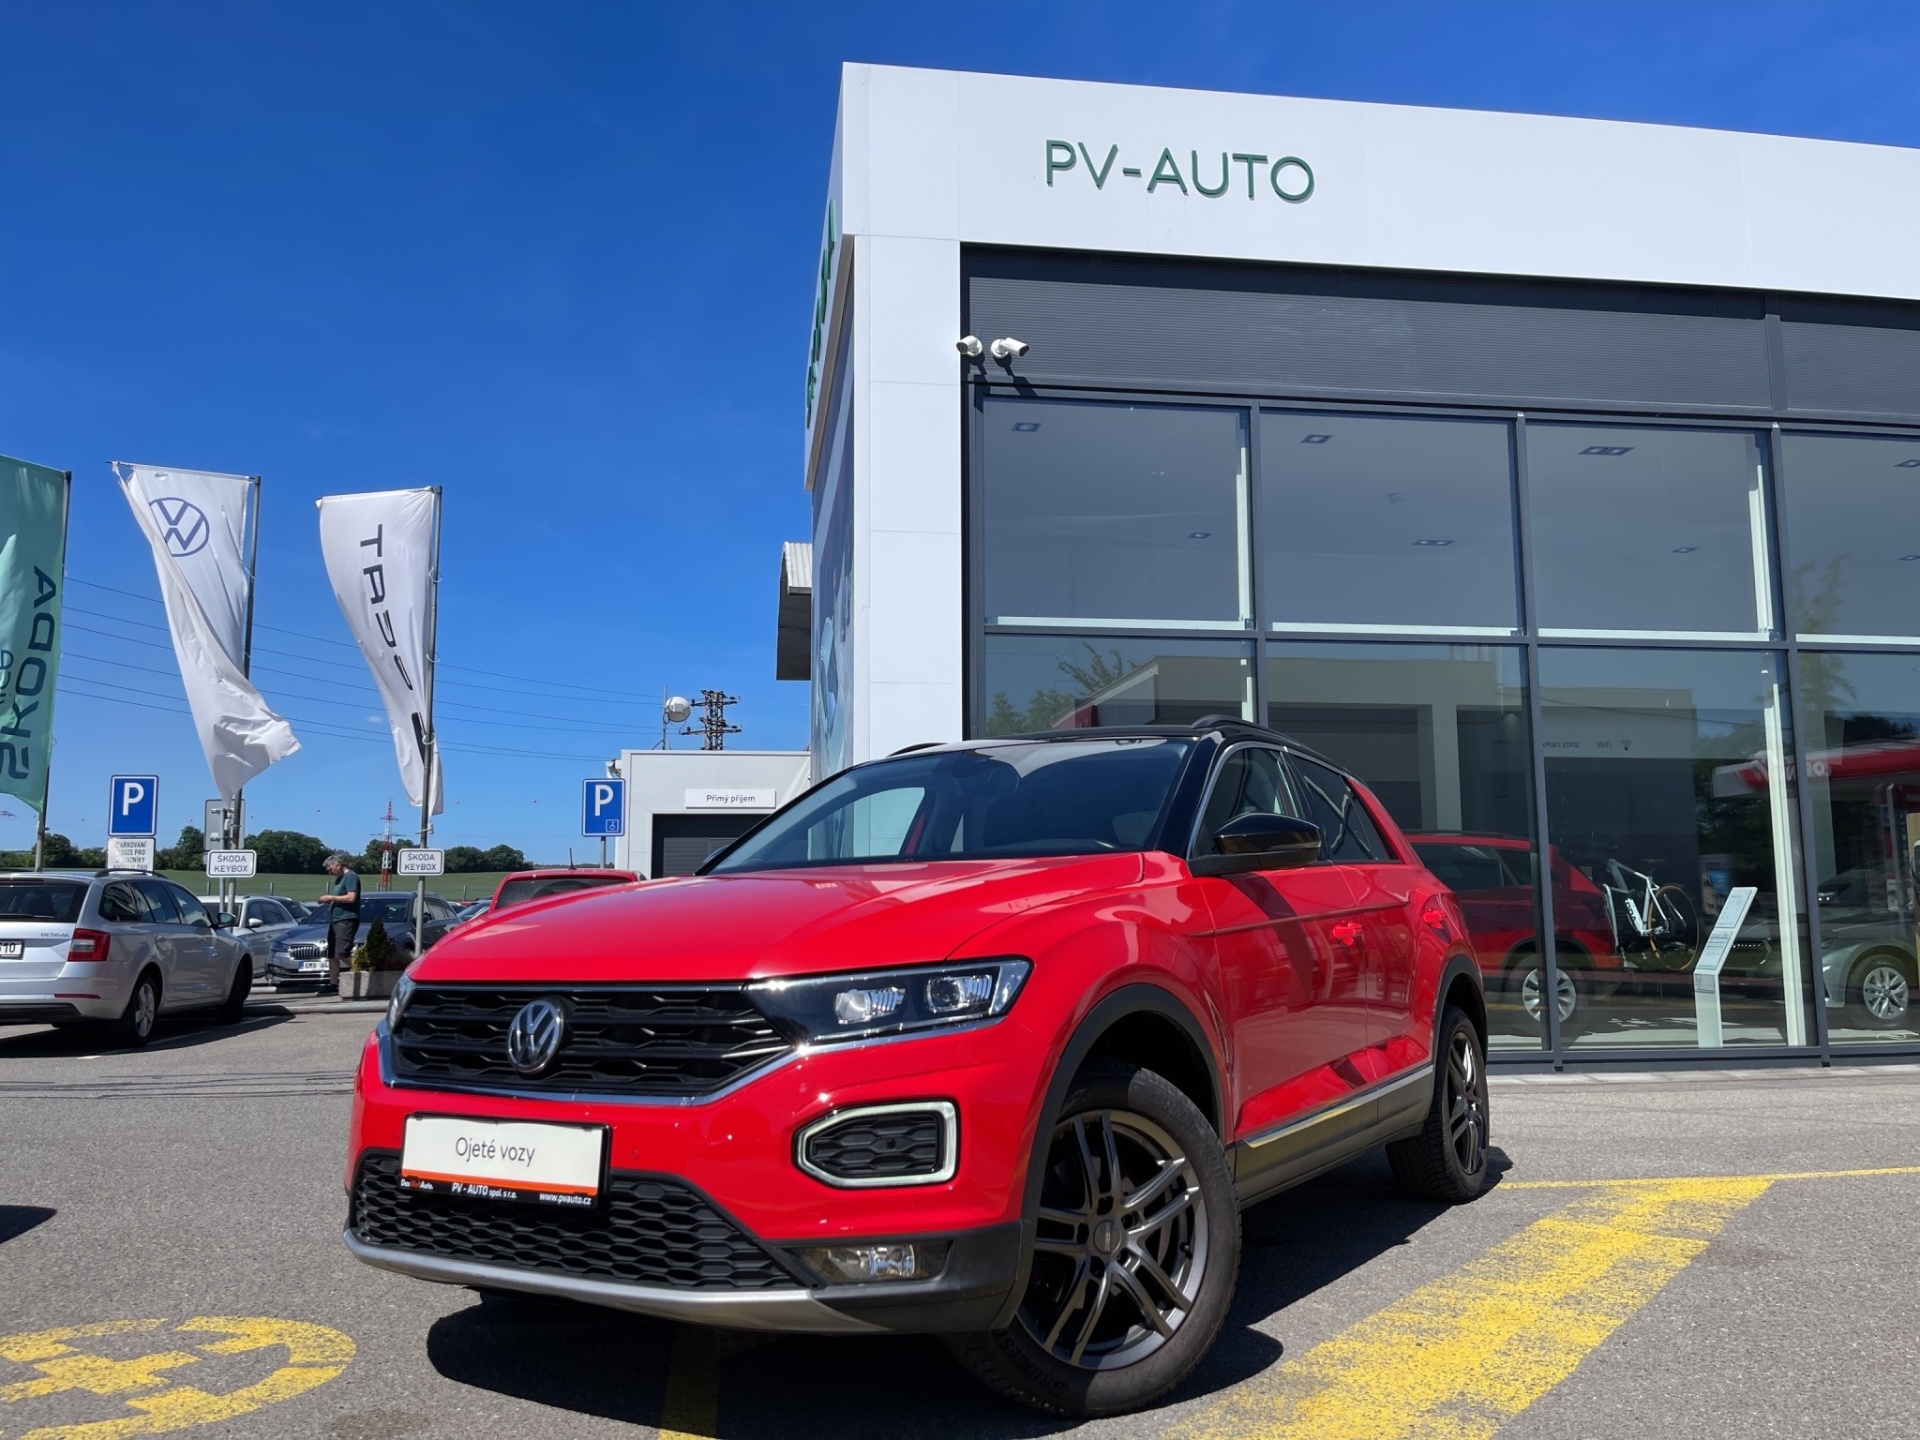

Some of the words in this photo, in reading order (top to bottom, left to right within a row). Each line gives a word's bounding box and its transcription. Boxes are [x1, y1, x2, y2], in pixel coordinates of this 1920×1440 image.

[1046, 139, 1314, 203] PV-AUTO
[122, 782, 144, 816] P
[594, 784, 614, 817] P
[217, 853, 247, 863] ŠKODA
[404, 863, 437, 871] KEYBOX
[456, 1137, 495, 1162] Ojeté
[500, 1146, 536, 1167] vozy
[452, 1182, 462, 1193] PV
[467, 1185, 489, 1196] AUTO
[539, 1192, 592, 1205] www.pvauto.cz
